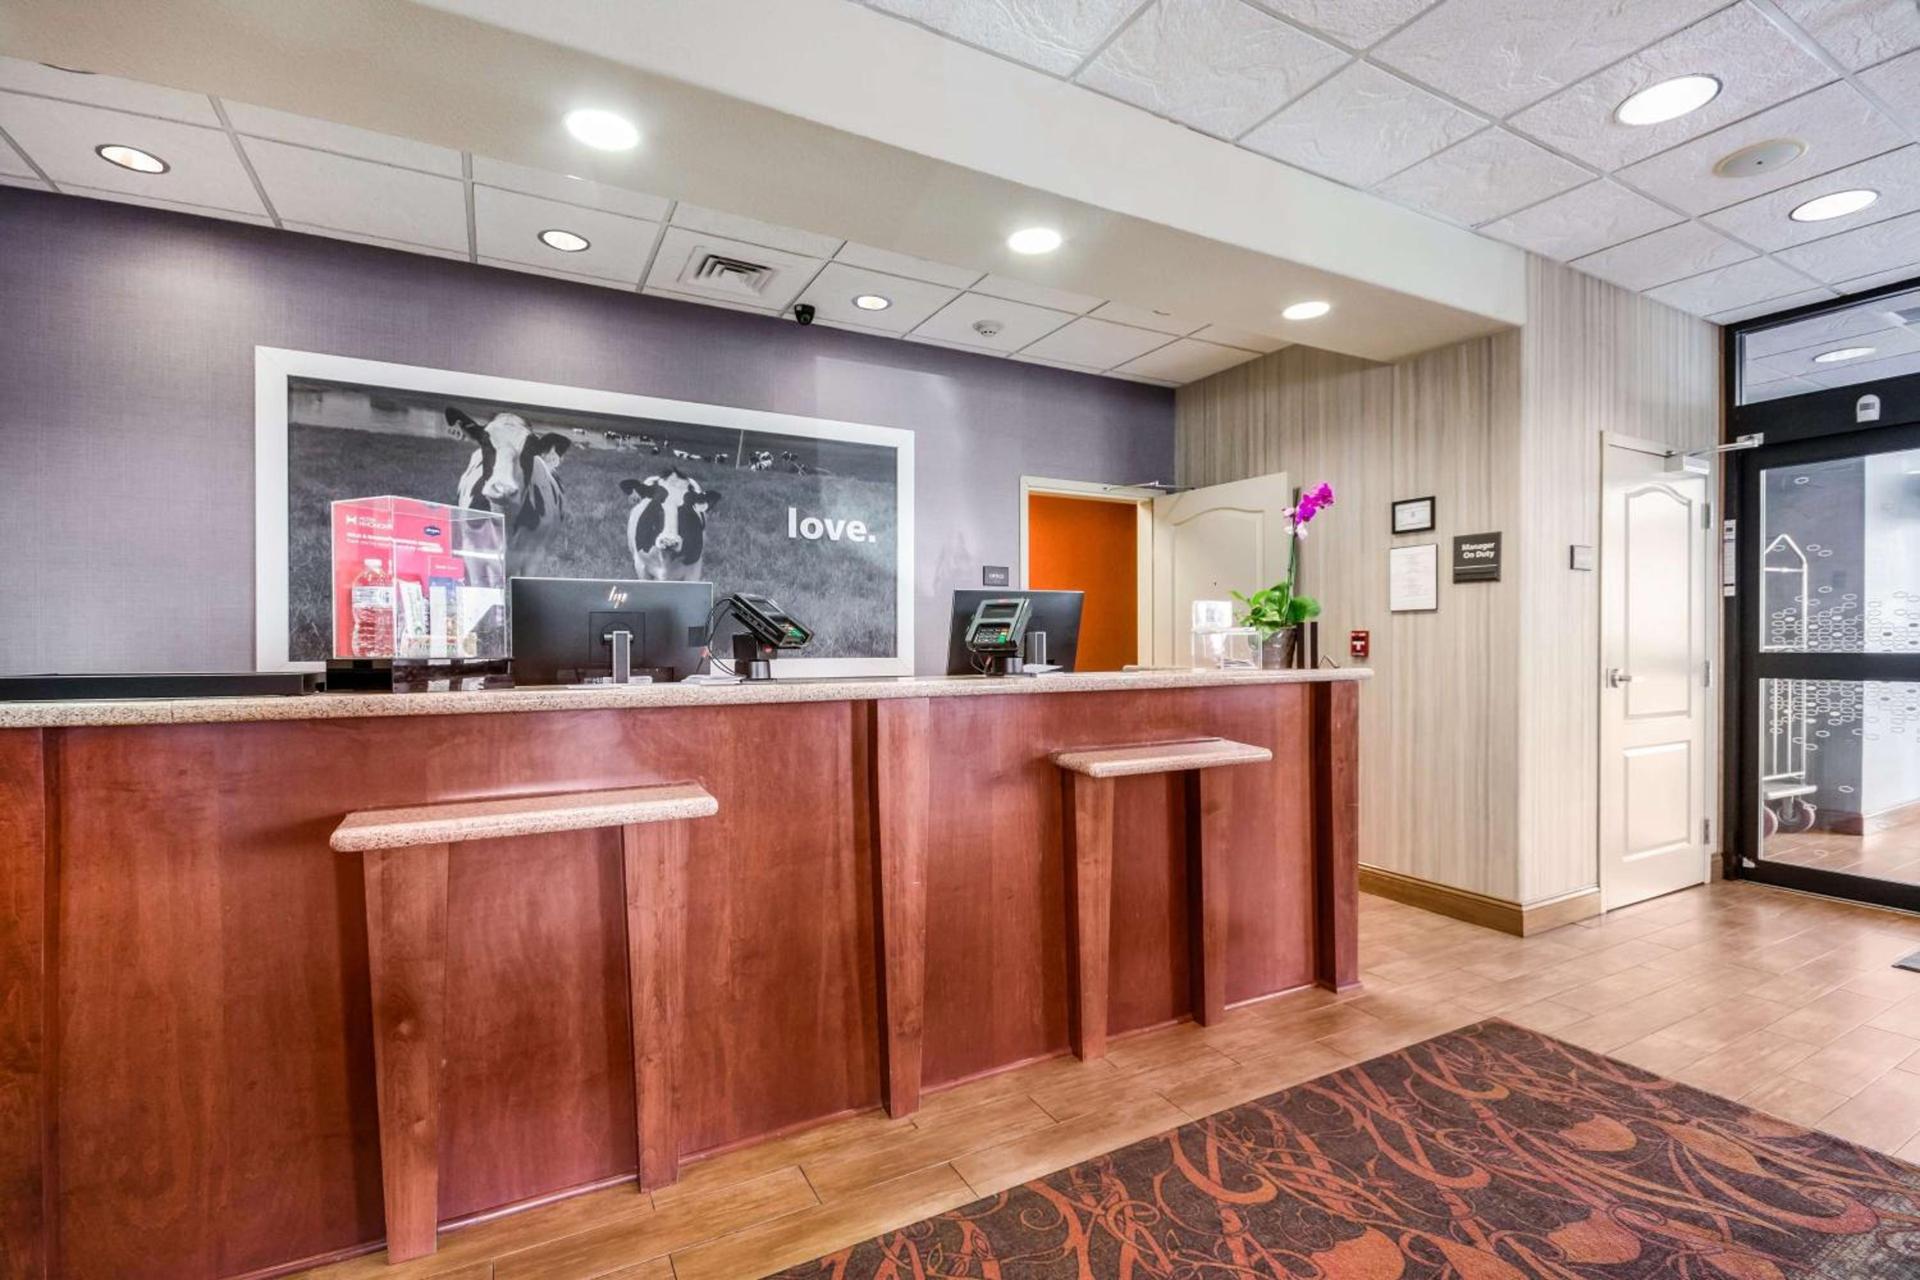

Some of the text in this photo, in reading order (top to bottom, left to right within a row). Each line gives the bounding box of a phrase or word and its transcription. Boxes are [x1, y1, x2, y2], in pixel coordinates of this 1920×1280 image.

[788, 506, 876, 543] love.
[1461, 542, 1496, 551] Manager
[1463, 550, 1496, 560] On Duty
